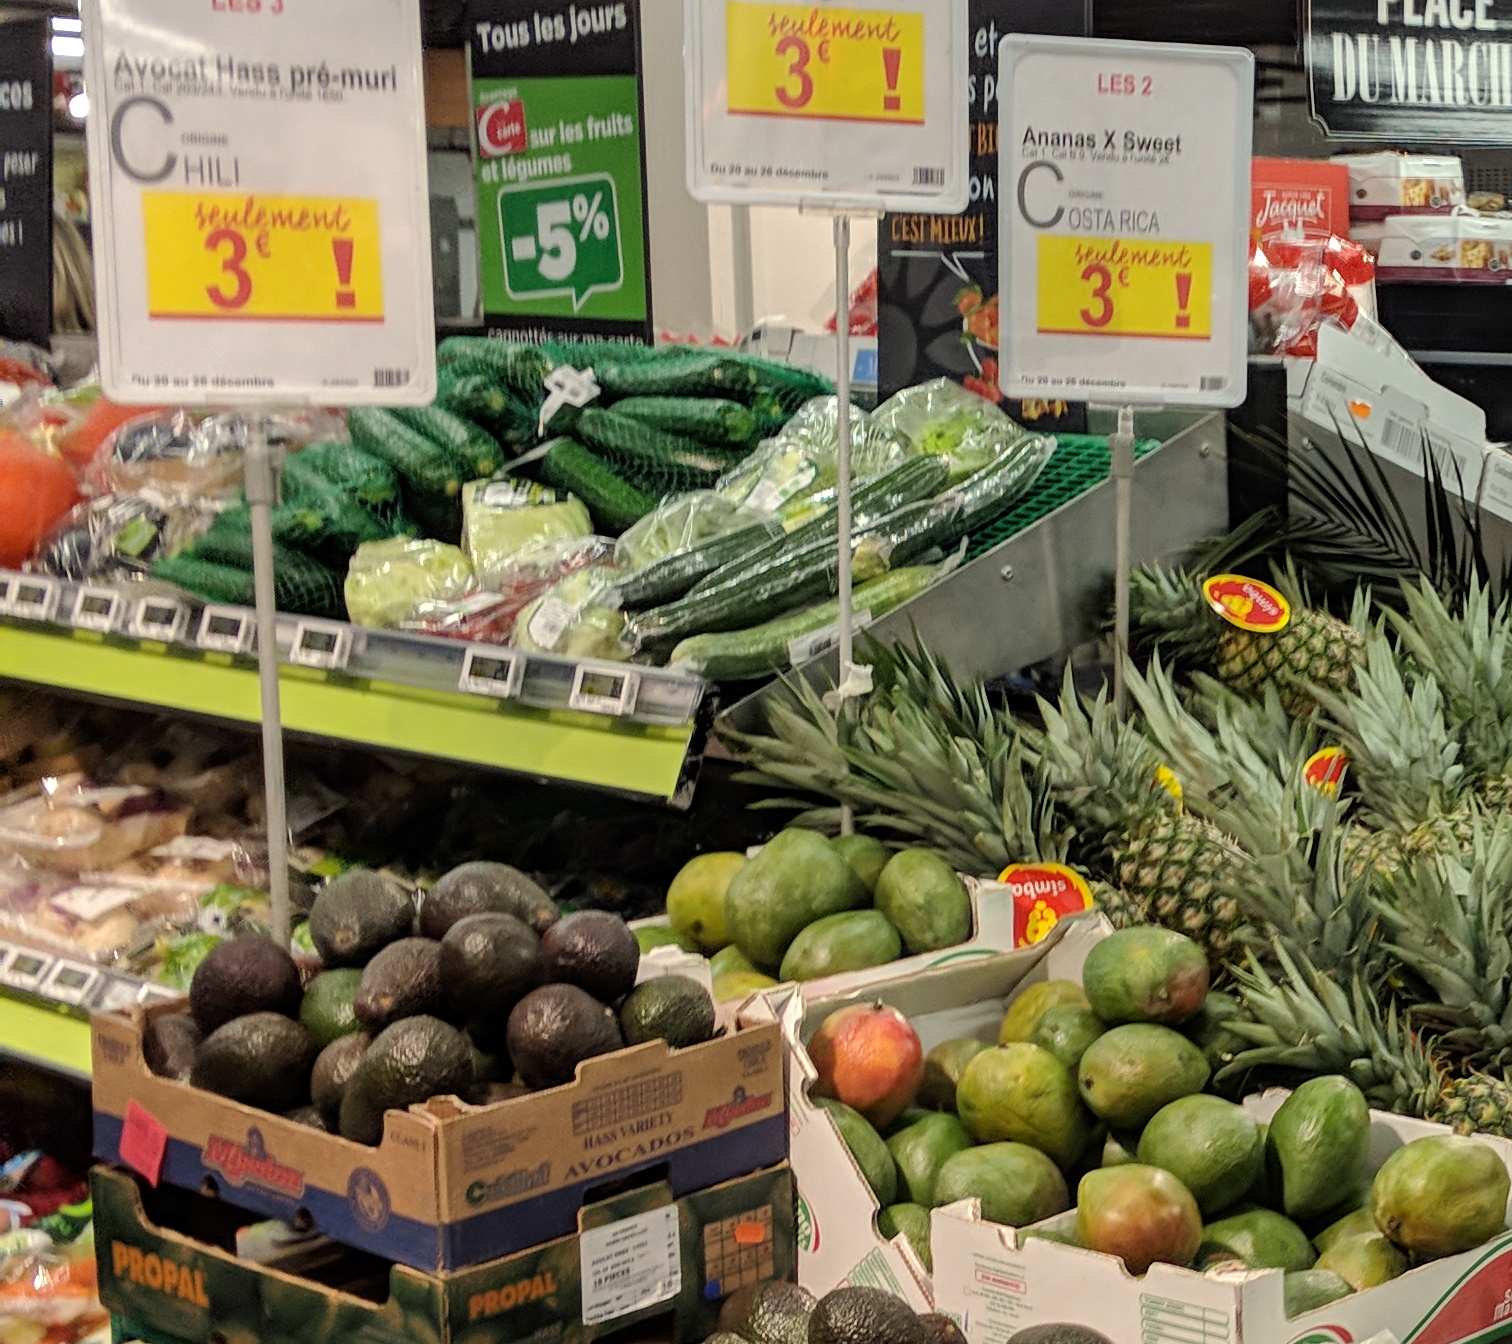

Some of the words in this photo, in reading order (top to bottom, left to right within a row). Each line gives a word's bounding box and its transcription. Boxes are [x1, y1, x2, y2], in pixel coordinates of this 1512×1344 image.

[476, 21, 530, 54] Tous
[534, 10, 566, 45] les
[768, 7, 901, 42] seulement
[114, 49, 207, 84] Avocat
[215, 55, 281, 89] Hass
[290, 61, 398, 94] pré-muri
[1097, 72, 1135, 96] LES
[1141, 75, 1153, 97] 2
[1331, 31, 1380, 103] DU
[530, 126, 556, 150] sur
[559, 119, 584, 145] les
[586, 112, 634, 142] fruits
[1022, 125, 1097, 150] Ananas
[1102, 128, 1117, 151] X
[1123, 130, 1182, 154] Sweet
[481, 159, 499, 184] et
[501, 152, 573, 184] légumes
[195, 196, 351, 232] seulement
[1119, 208, 1160, 233] RICA
[1256, 190, 1325, 228] Jacquet
[930, 213, 976, 244] MIEUX
[1075, 239, 1192, 269] seulement
[620, 1111, 674, 1138] VARIETY
[564, 1124, 696, 1181] AVOCADOS
[112, 1240, 210, 1308] PROPAL
[469, 1271, 557, 1320] PROPAL
